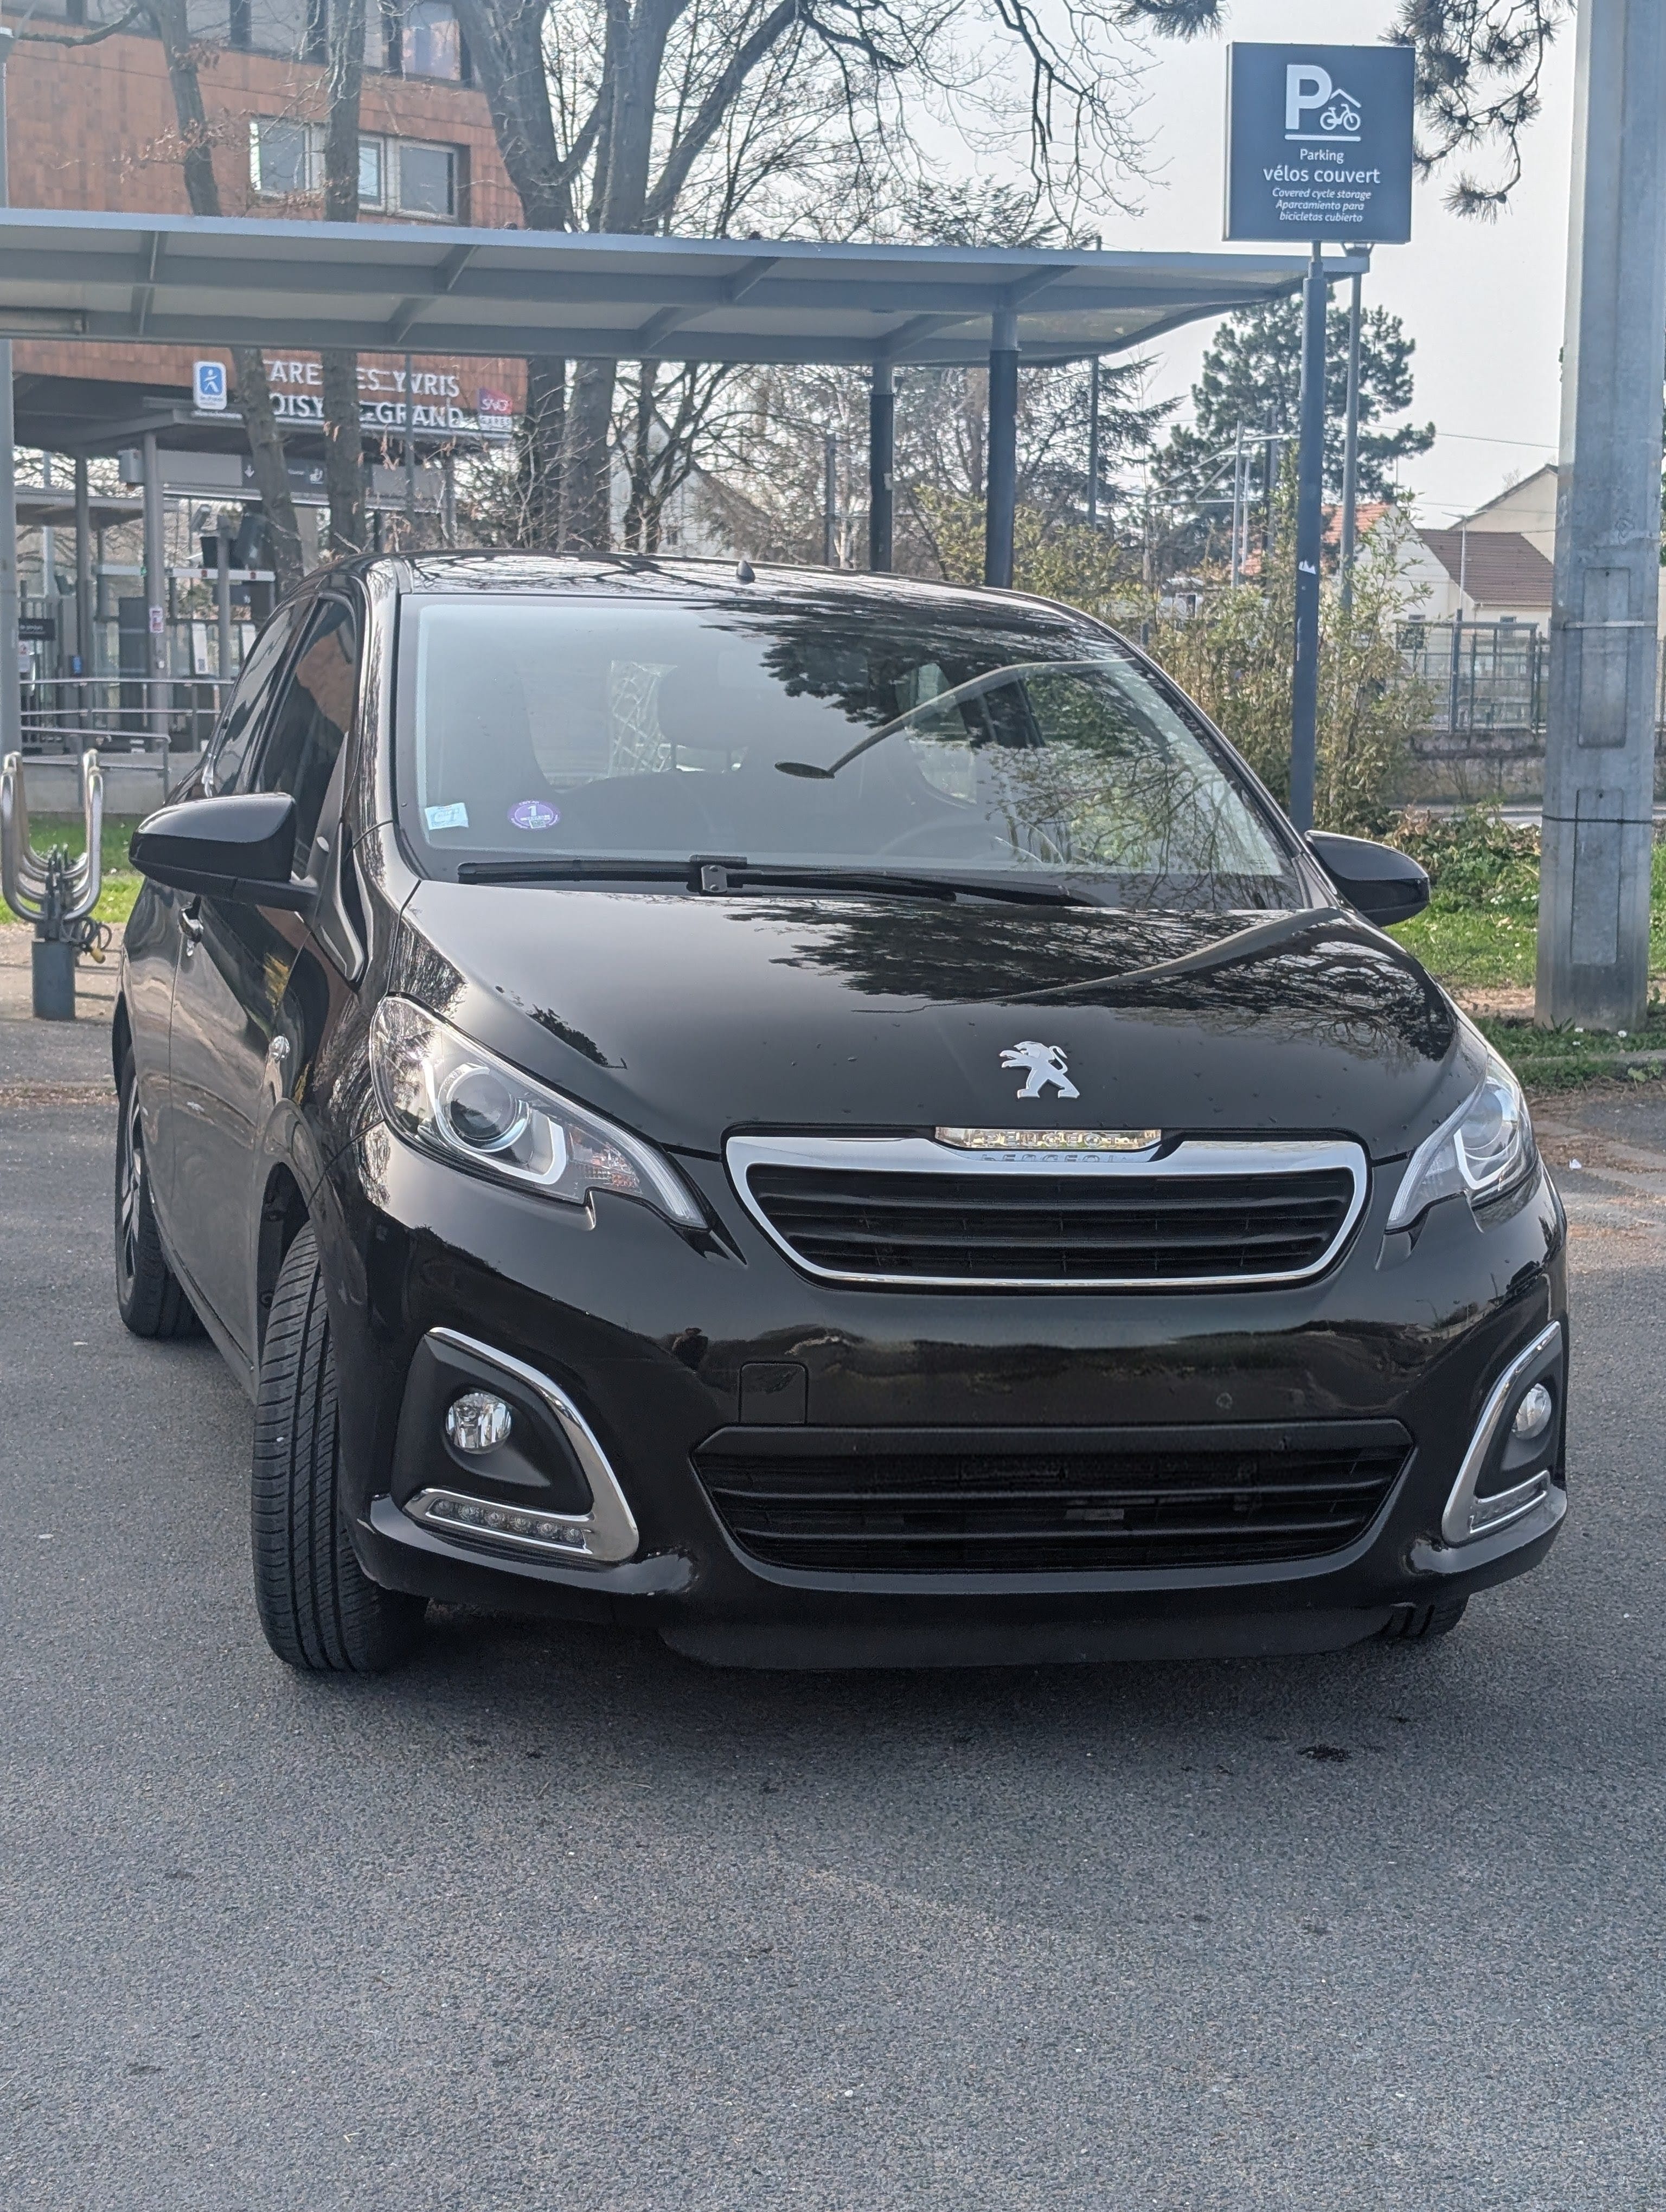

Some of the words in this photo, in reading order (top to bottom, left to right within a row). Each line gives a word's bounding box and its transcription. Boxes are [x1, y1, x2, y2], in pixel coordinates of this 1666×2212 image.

[1285, 64, 1332, 130] P
[1300, 149, 1344, 164] Parking
[1263, 164, 1309, 182] vélos
[1314, 169, 1380, 183] couvert
[1272, 187, 1310, 197] Covered
[1312, 189, 1335, 200] cycle
[1337, 190, 1372, 201] storage
[1276, 200, 1341, 210] Aparcamiento
[1342, 203, 1364, 212] para
[1279, 211, 1323, 221] bicicletas
[1324, 213, 1363, 223] cubierto
[270, 361, 324, 385] ARE
[527, 805, 537, 816] 1
[986, 1131, 1121, 1148] PEUGEOT
